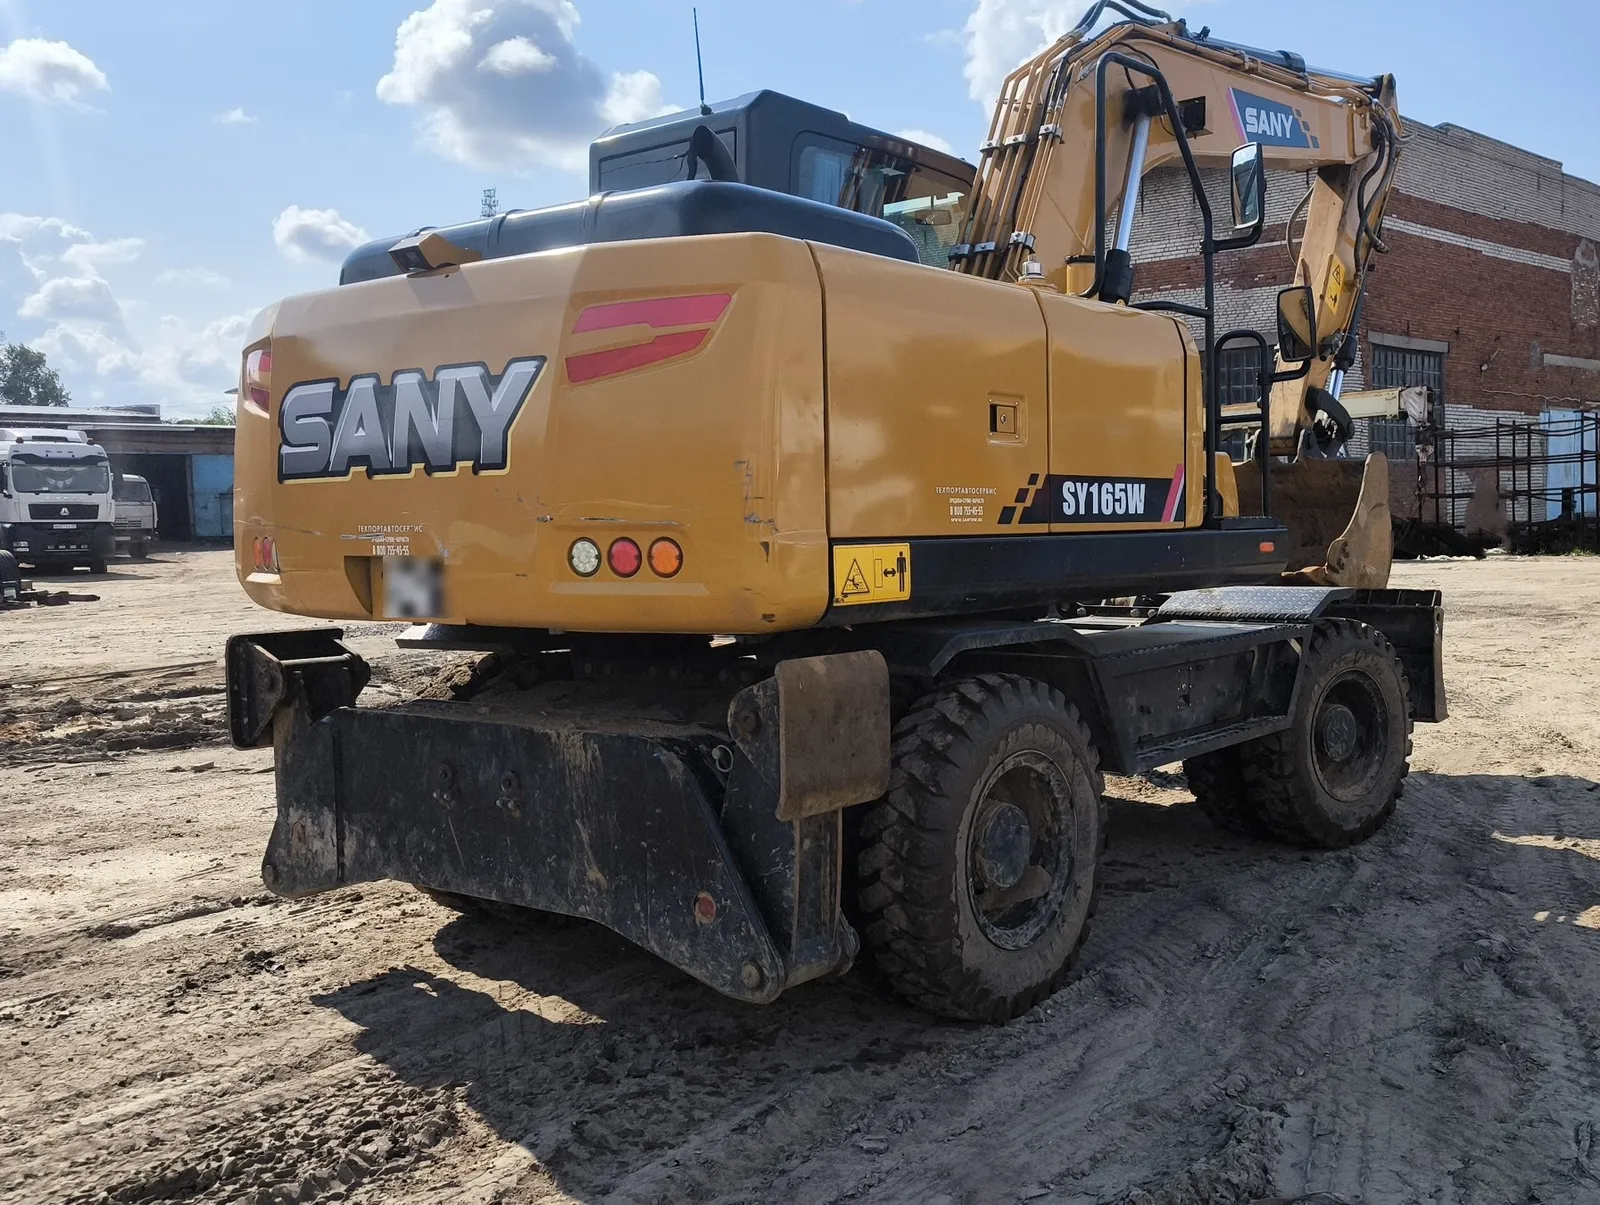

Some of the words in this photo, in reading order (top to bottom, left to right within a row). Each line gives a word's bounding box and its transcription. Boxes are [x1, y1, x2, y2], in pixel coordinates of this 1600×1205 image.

[1245, 107, 1294, 139] SANY
[278, 355, 547, 484] SANY
[1062, 481, 1146, 515] SY165W
